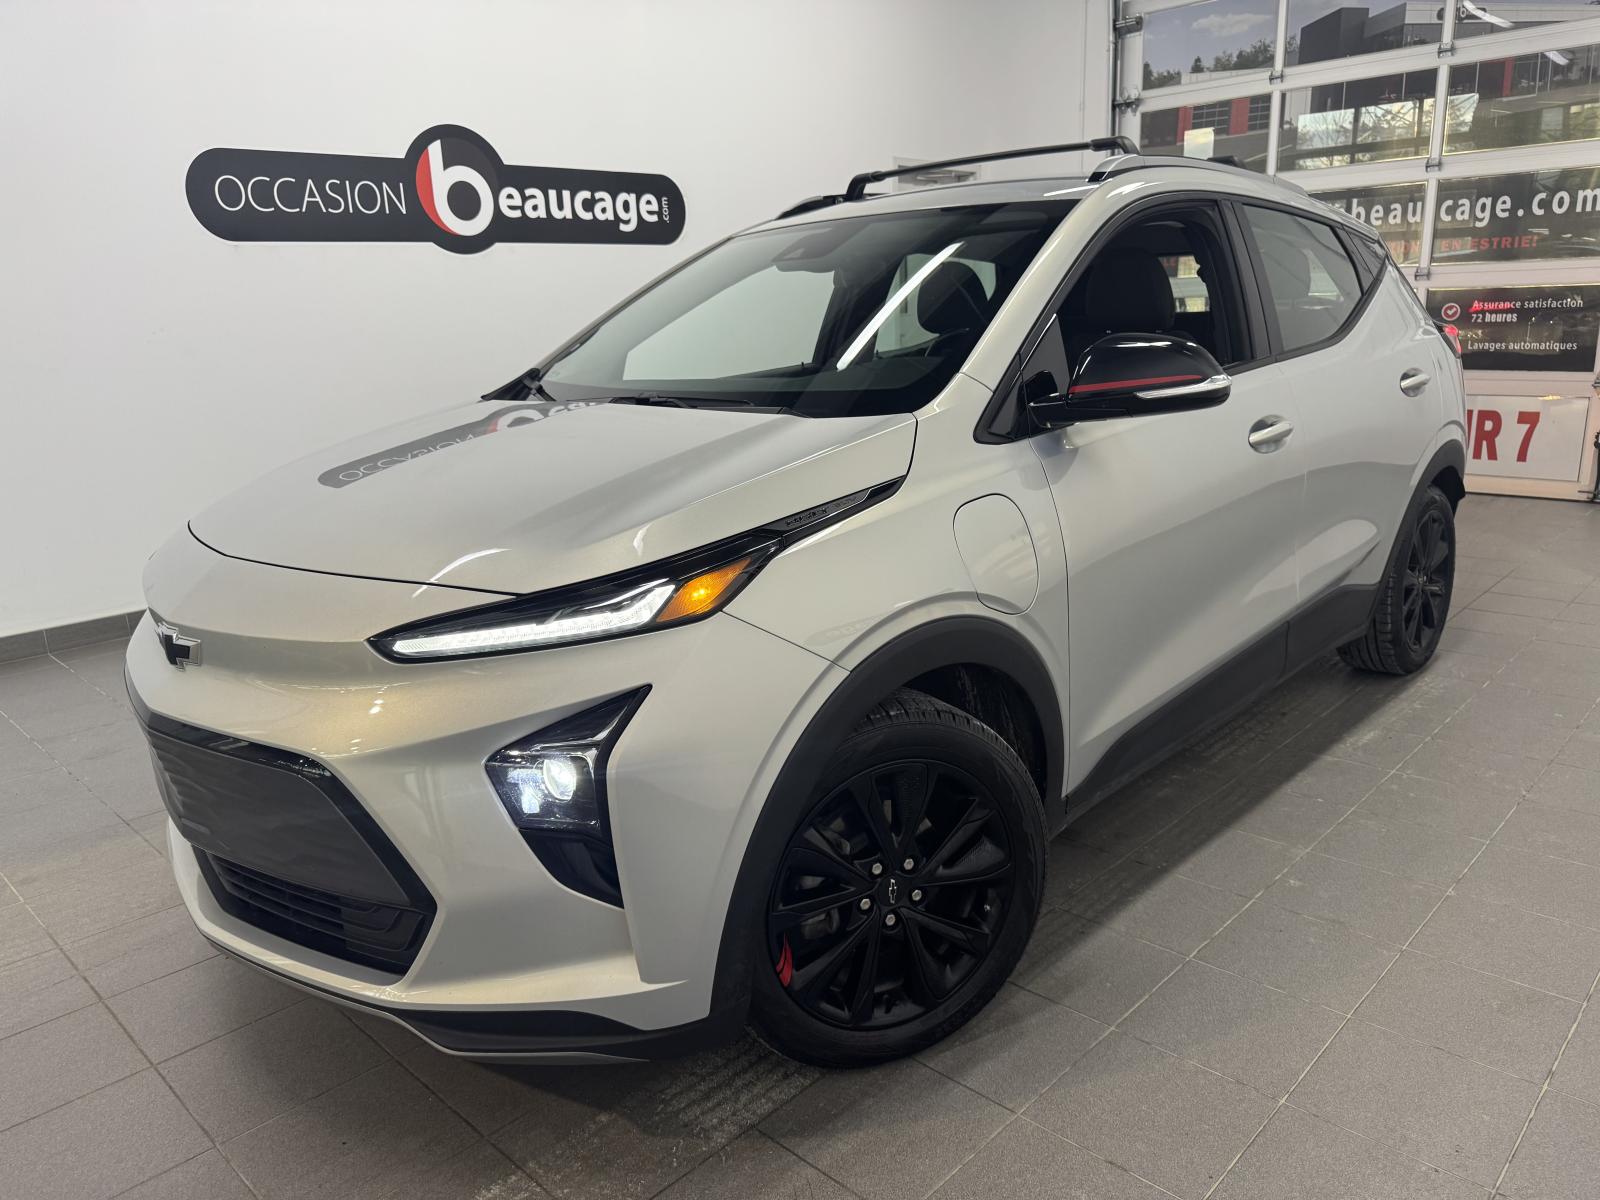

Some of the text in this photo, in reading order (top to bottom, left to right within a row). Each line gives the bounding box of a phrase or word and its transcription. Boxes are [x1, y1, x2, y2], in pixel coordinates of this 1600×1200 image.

[214, 138, 659, 237] OCCASION beaucage
[661, 196, 670, 223] .com
[1327, 187, 1600, 228] beaucage.com
[1440, 238, 1463, 252] EN
[1471, 233, 1538, 251] ESTRIE!
[1472, 297, 1584, 310] Assurance satisfaction
[1471, 312, 1518, 323] 72 heures
[1468, 341, 1578, 352] Lavages automatiques
[1516, 411, 1541, 463] 7
